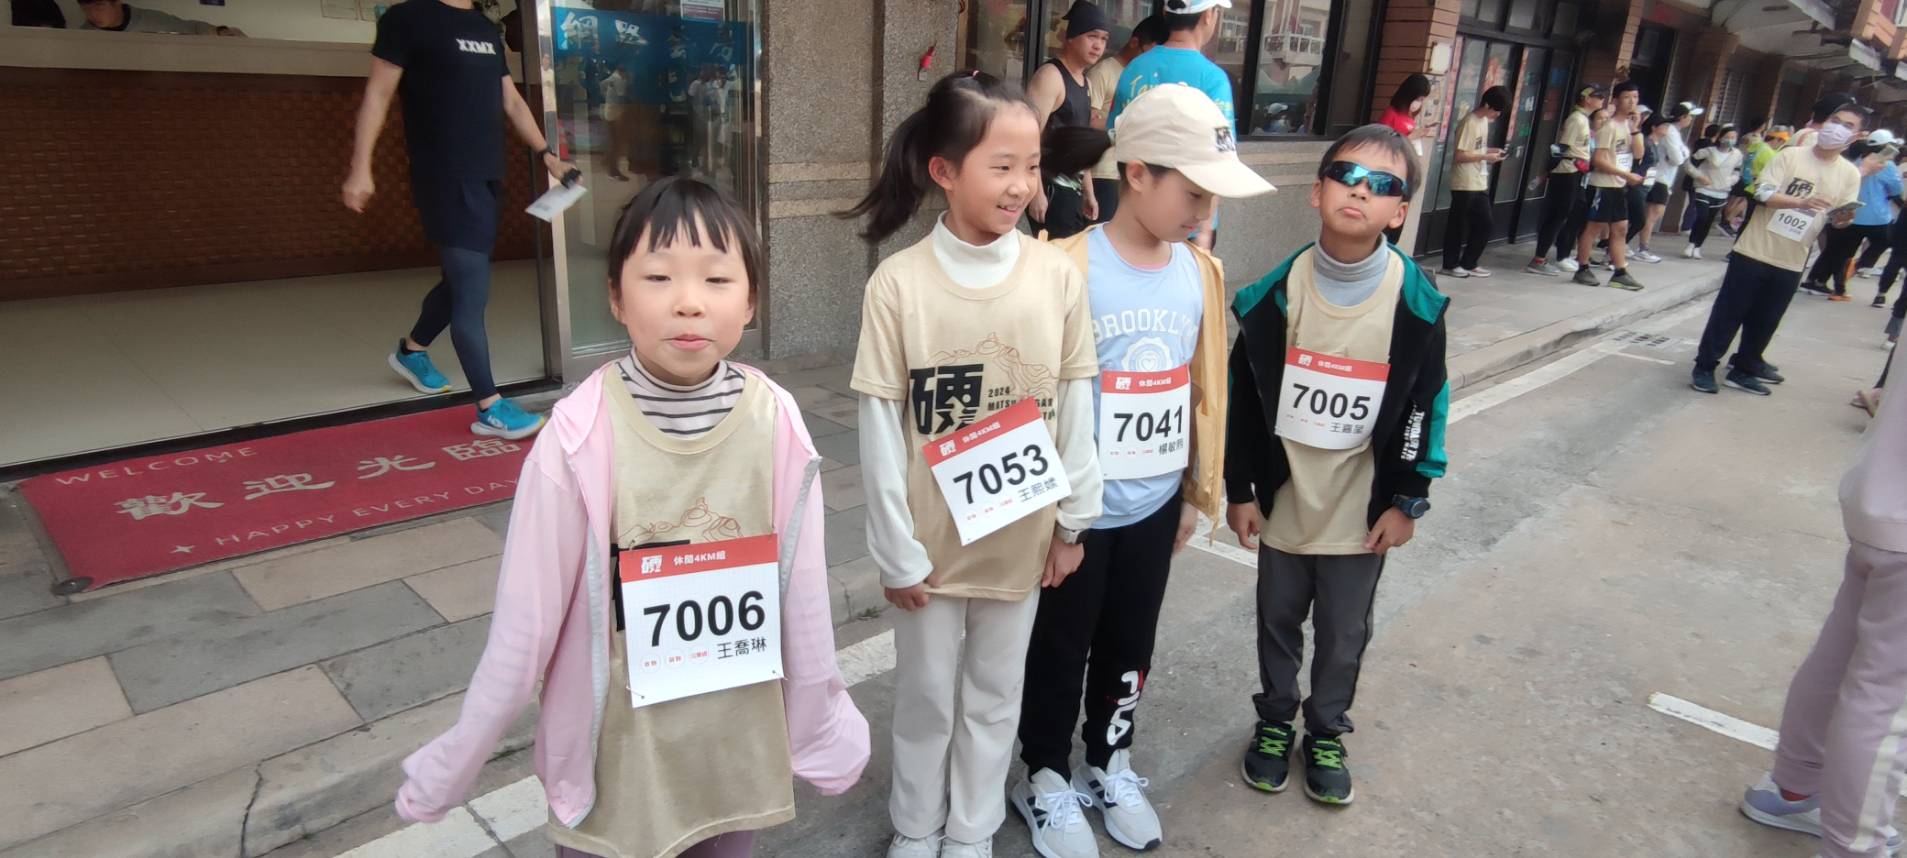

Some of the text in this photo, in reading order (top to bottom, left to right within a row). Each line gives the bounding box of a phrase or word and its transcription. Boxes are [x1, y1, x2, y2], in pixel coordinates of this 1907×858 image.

[1778, 213, 1807, 230] 1002
[988, 386, 1010, 397] 2024
[1293, 383, 1371, 420] 7005
[1113, 405, 1183, 442] 7041
[56, 447, 257, 486] WELCOME
[113, 439, 521, 520] 歡迎光臨
[953, 444, 1048, 505] 7053
[215, 478, 518, 545] HAPPY EVERY DAY
[643, 590, 765, 648] 7006
[717, 637, 767, 659] 王喬琳
[1107, 670, 1143, 745] FILA
